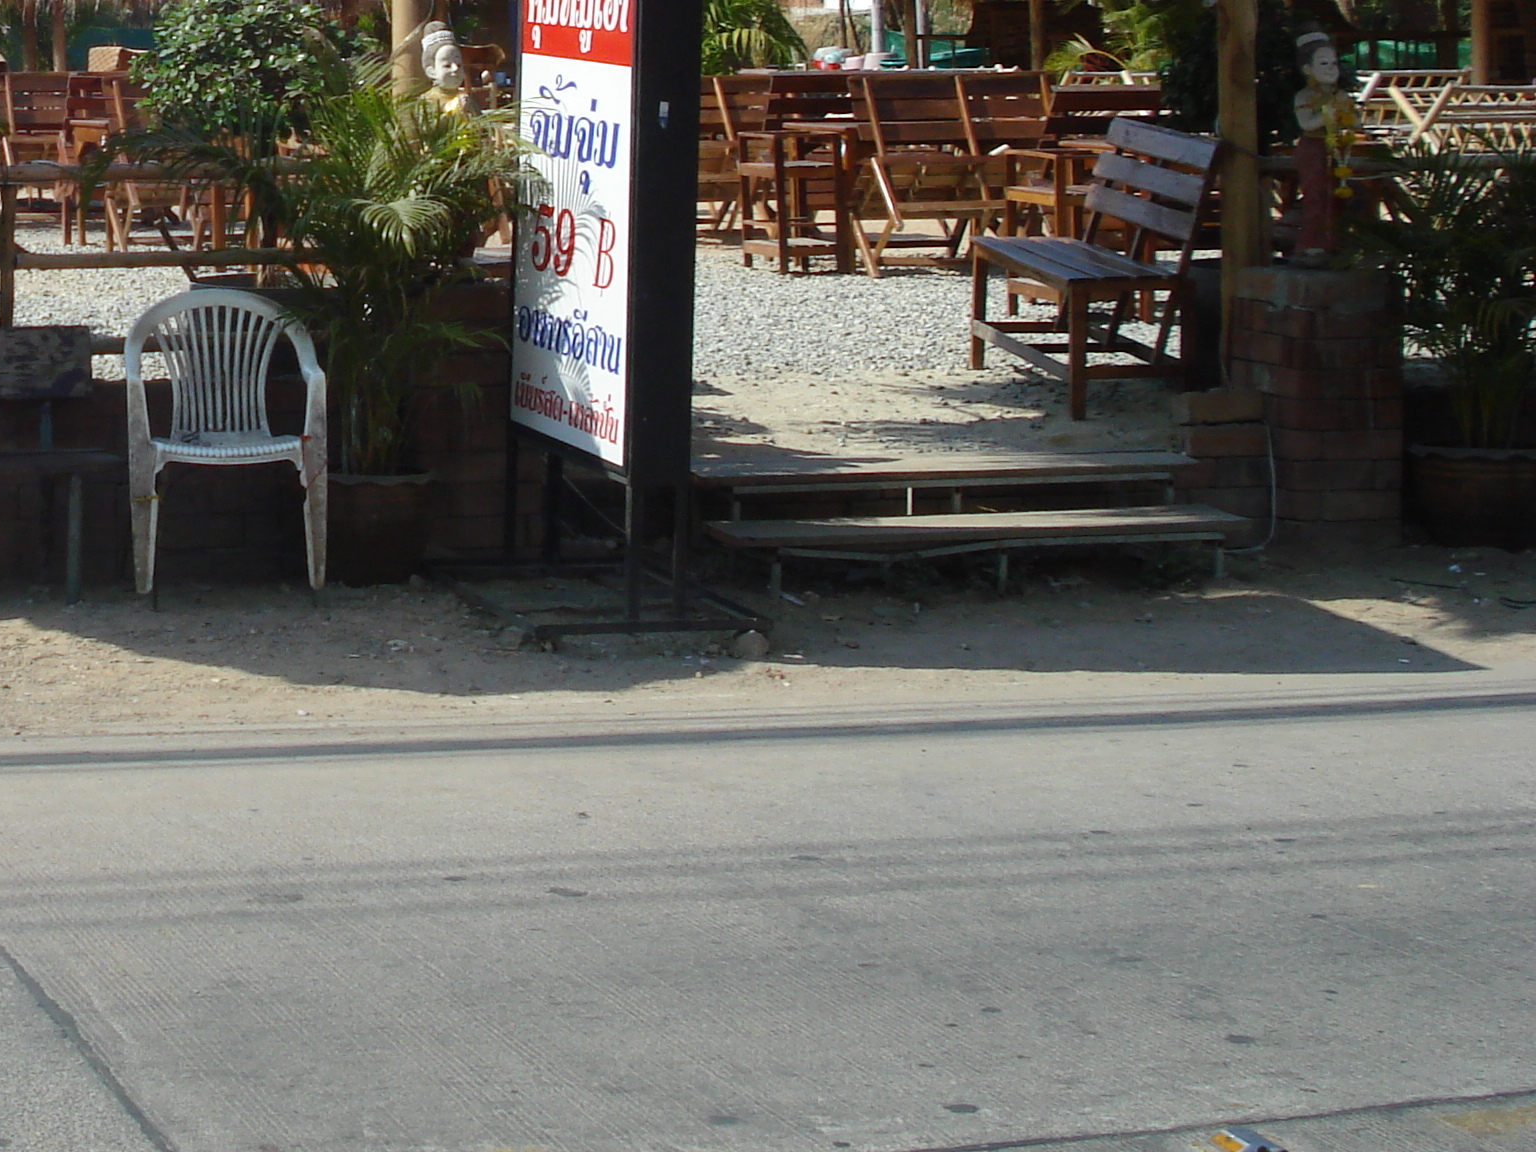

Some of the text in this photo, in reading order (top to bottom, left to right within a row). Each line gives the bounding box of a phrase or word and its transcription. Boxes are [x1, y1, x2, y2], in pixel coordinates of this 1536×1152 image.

[529, 74, 621, 195] จิ้มจุ่ม
[531, 203, 576, 277] 59
[518, 305, 623, 376] อาหารอีสาน
